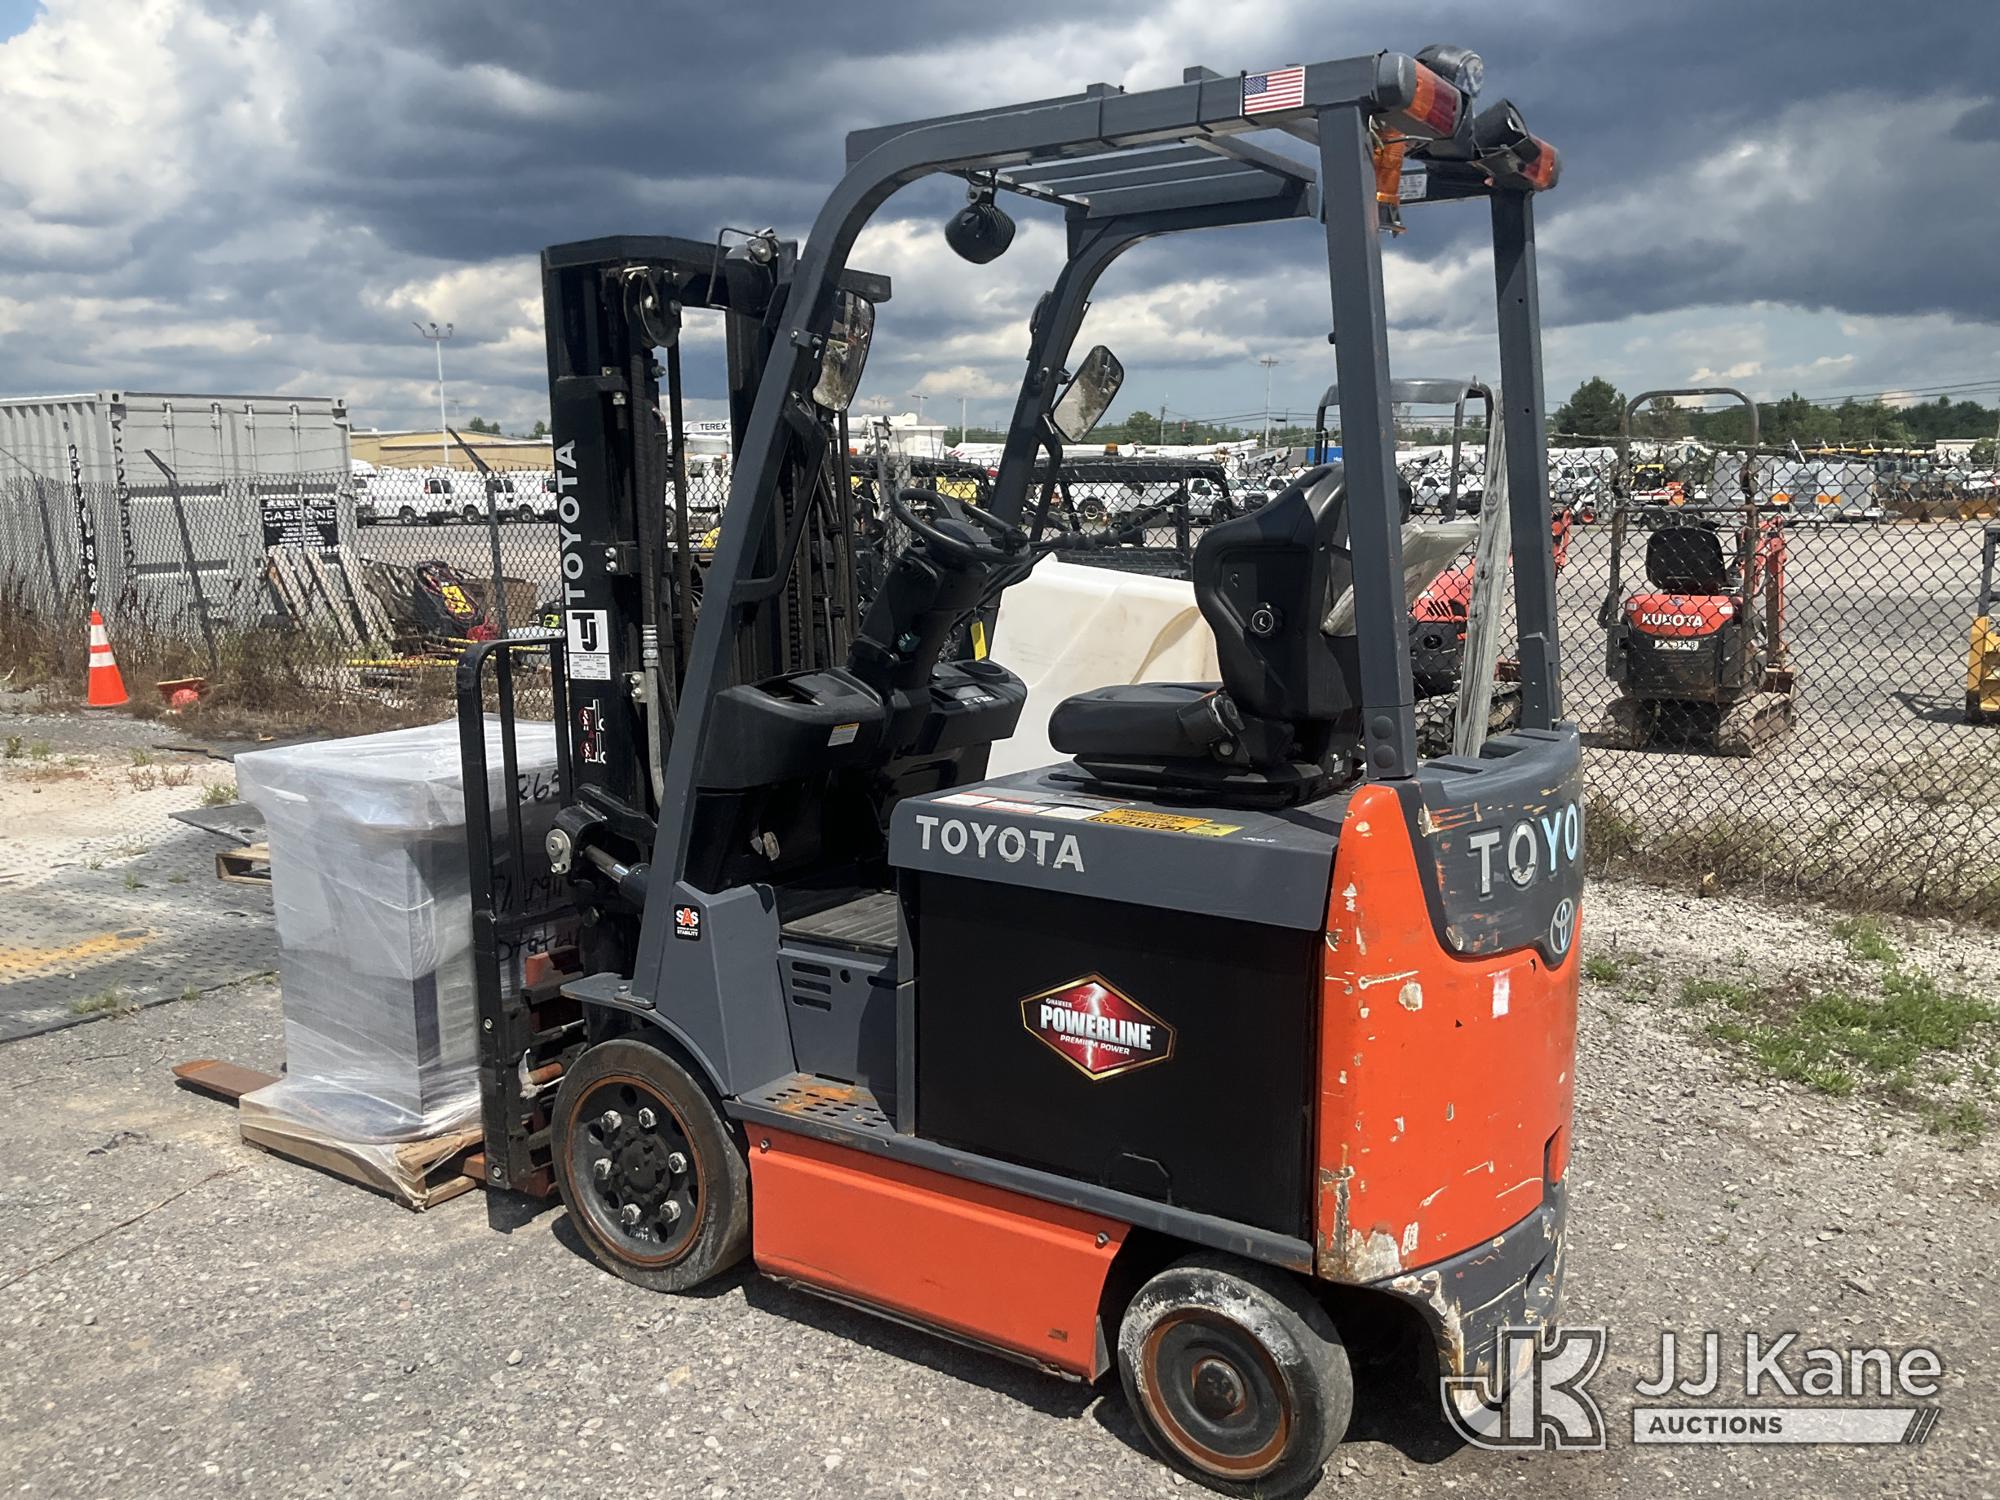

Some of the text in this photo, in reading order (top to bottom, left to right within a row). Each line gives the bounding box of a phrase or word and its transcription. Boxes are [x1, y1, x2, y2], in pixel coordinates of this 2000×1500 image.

[700, 422, 727, 430] TEREX
[555, 440, 586, 606] TOYOTA
[915, 814, 1085, 873] TOYOTA
[676, 907, 699, 927] SAS
[1040, 1004, 1151, 1050] POWERLINE
[1100, 1042, 1131, 1056] POWER
